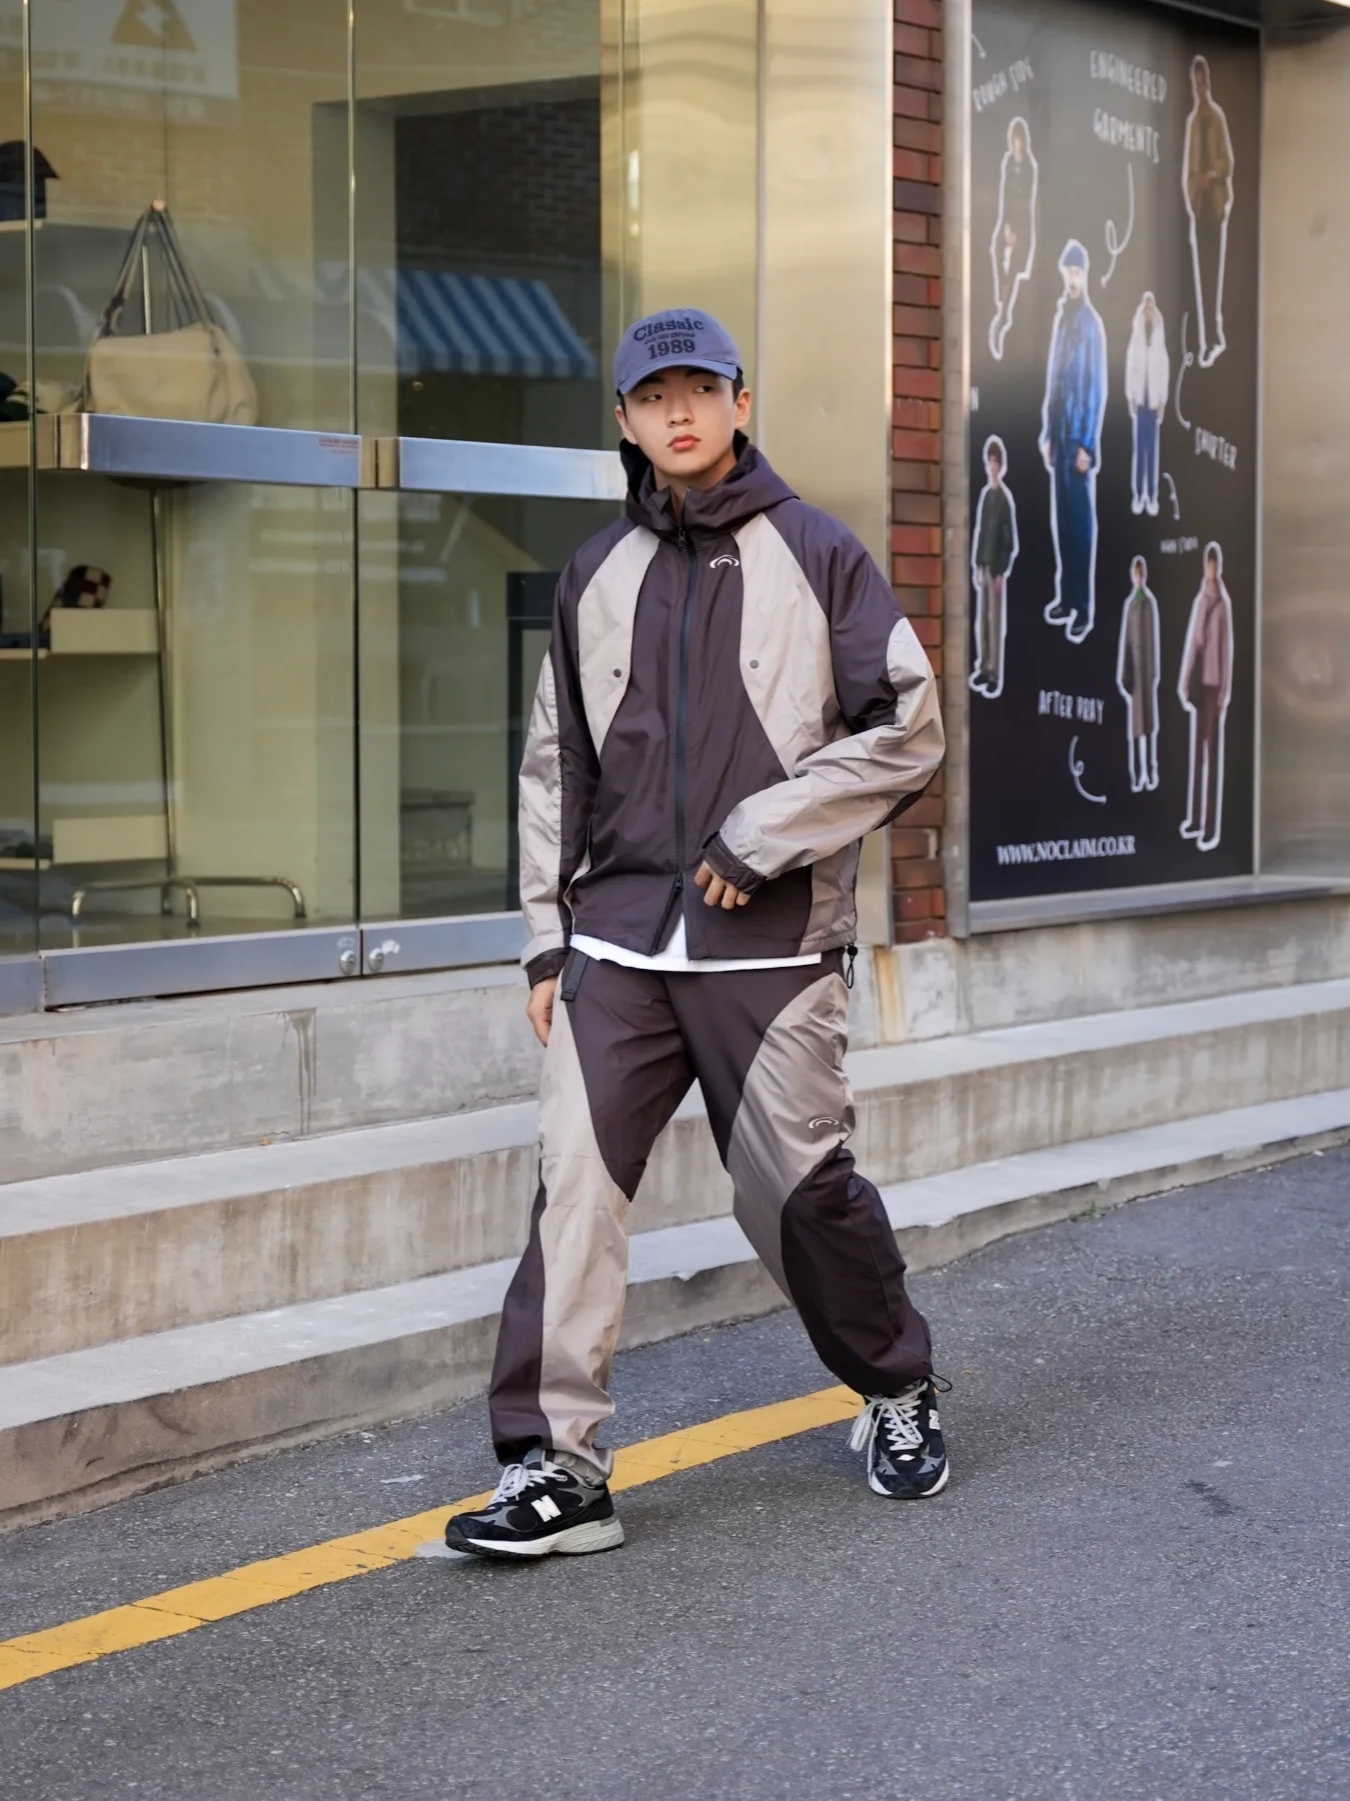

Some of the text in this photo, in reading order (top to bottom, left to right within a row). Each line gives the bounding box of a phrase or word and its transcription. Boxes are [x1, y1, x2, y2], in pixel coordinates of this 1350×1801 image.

[1090, 50, 1167, 103] ENGINEERED
[1093, 107, 1160, 164] GARMENTS
[633, 317, 704, 342] Classic
[648, 339, 696, 360] 1989
[1038, 689, 1073, 719] AFTER
[997, 834, 1136, 866] WWW.NOCLAIM.CO.KR
[531, 1494, 562, 1523] N
